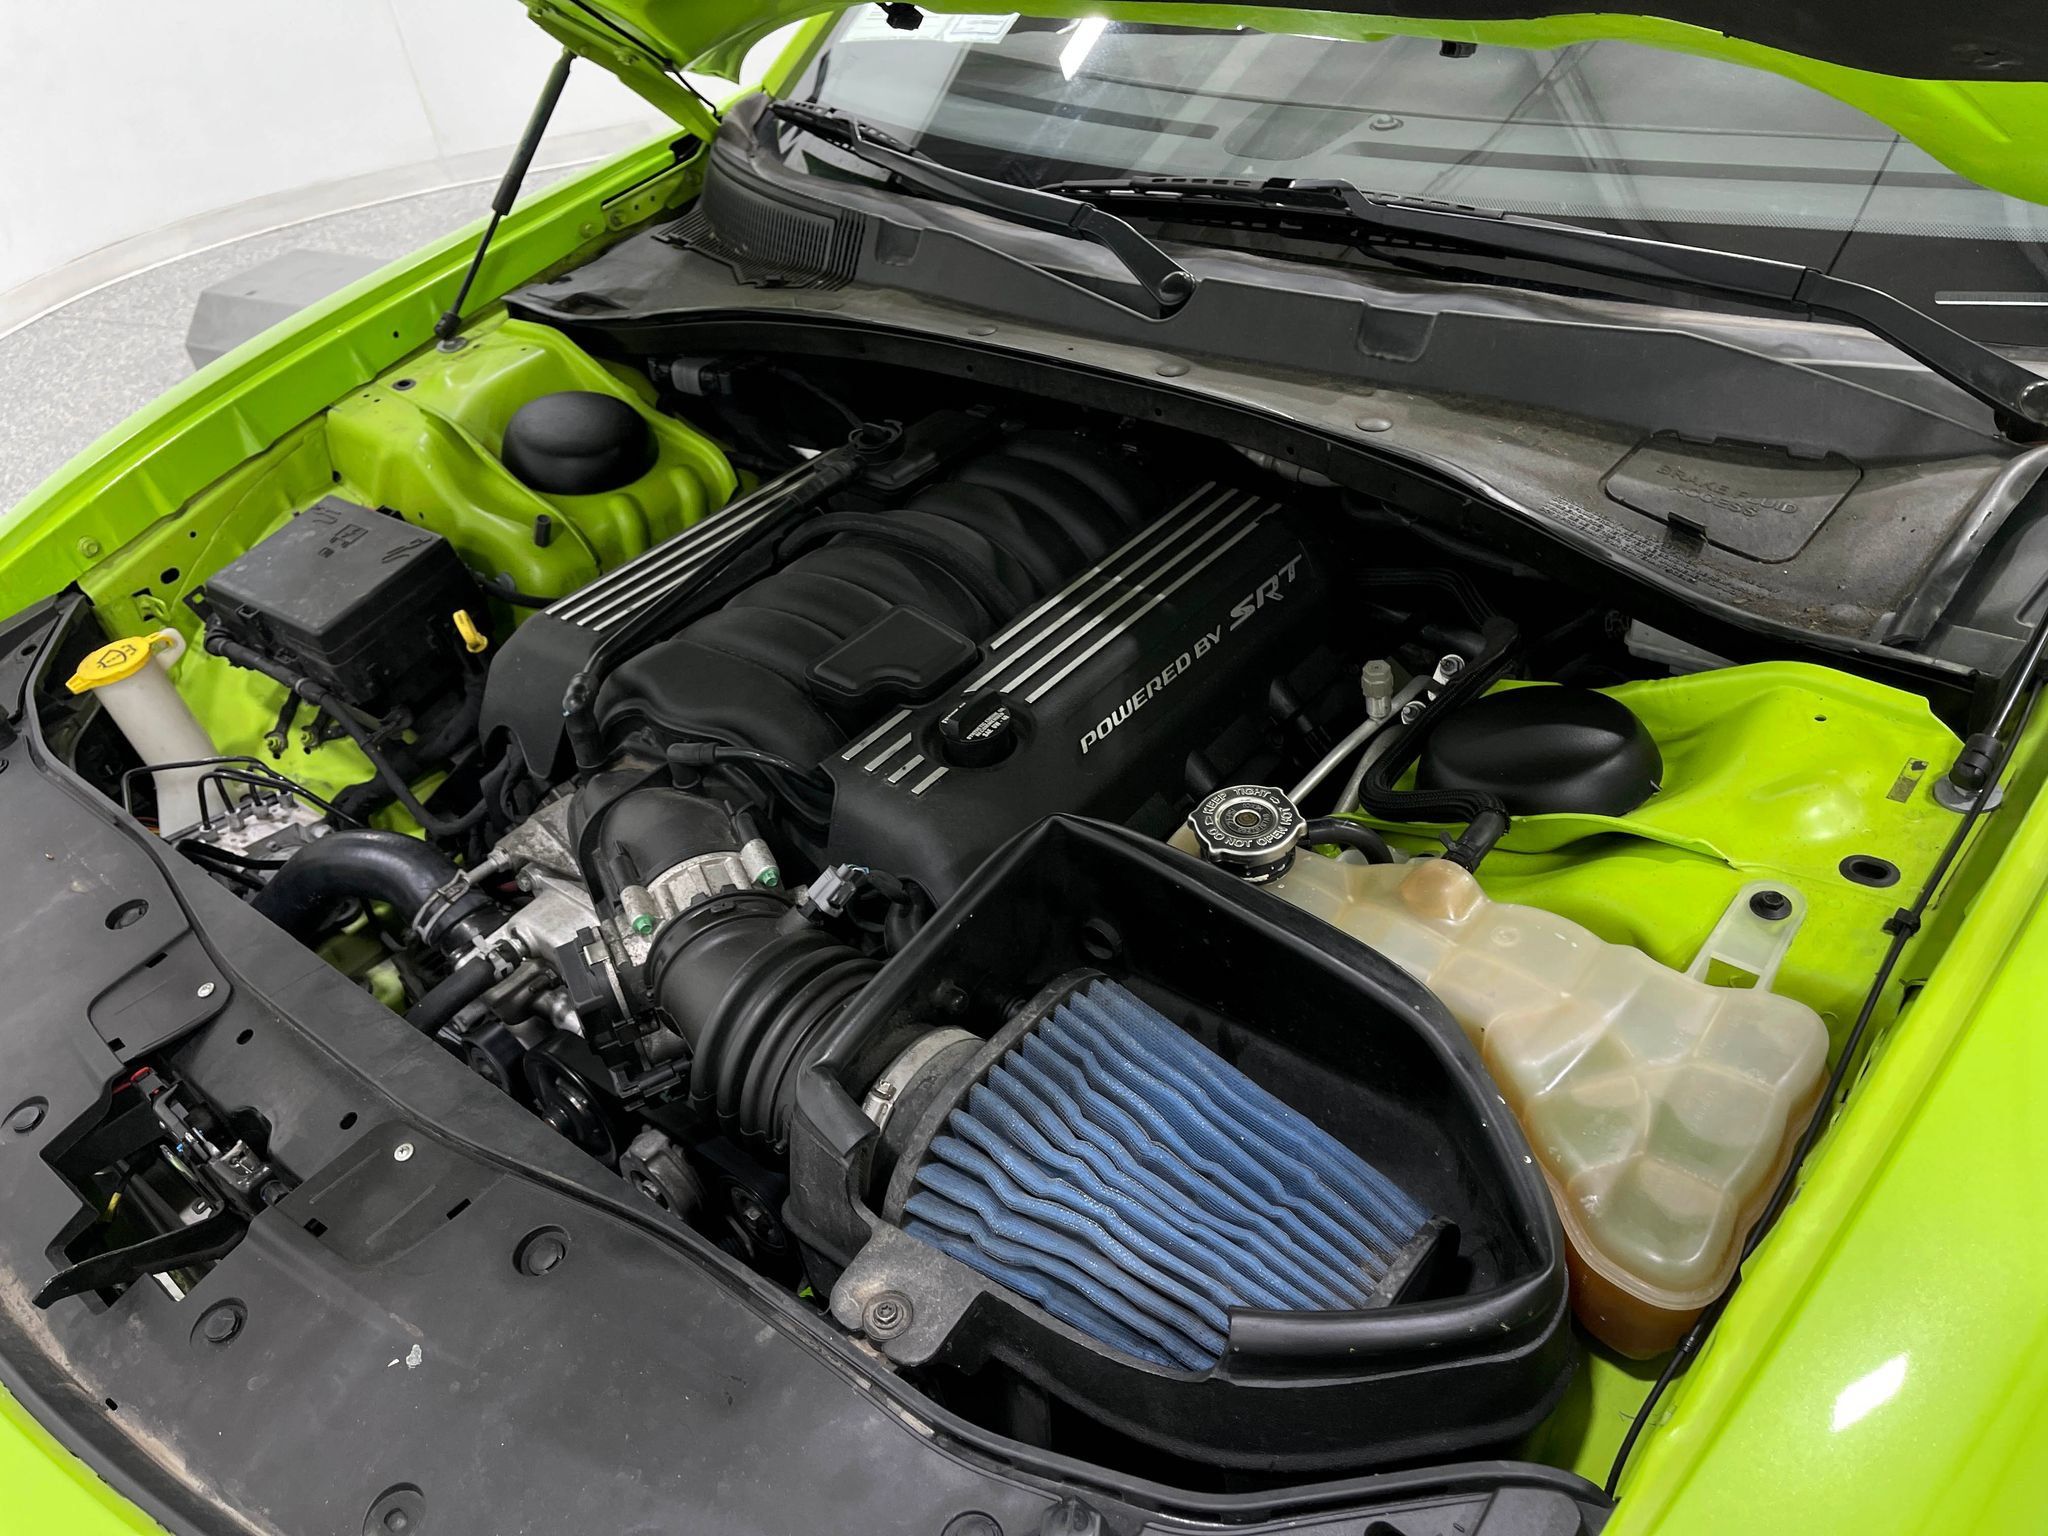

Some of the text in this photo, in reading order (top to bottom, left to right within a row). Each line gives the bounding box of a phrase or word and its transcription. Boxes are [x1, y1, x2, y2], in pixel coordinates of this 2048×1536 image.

[1079, 652, 1192, 754] POWERED
[1193, 624, 1221, 659] BY
[1229, 554, 1302, 632] SRT
[1203, 787, 1271, 815] KEEP TIGHT
[1206, 827, 1225, 841] DO
[1224, 837, 1253, 848] NOT
[1256, 825, 1289, 846] OPEN
[1279, 807, 1293, 826] HOT
